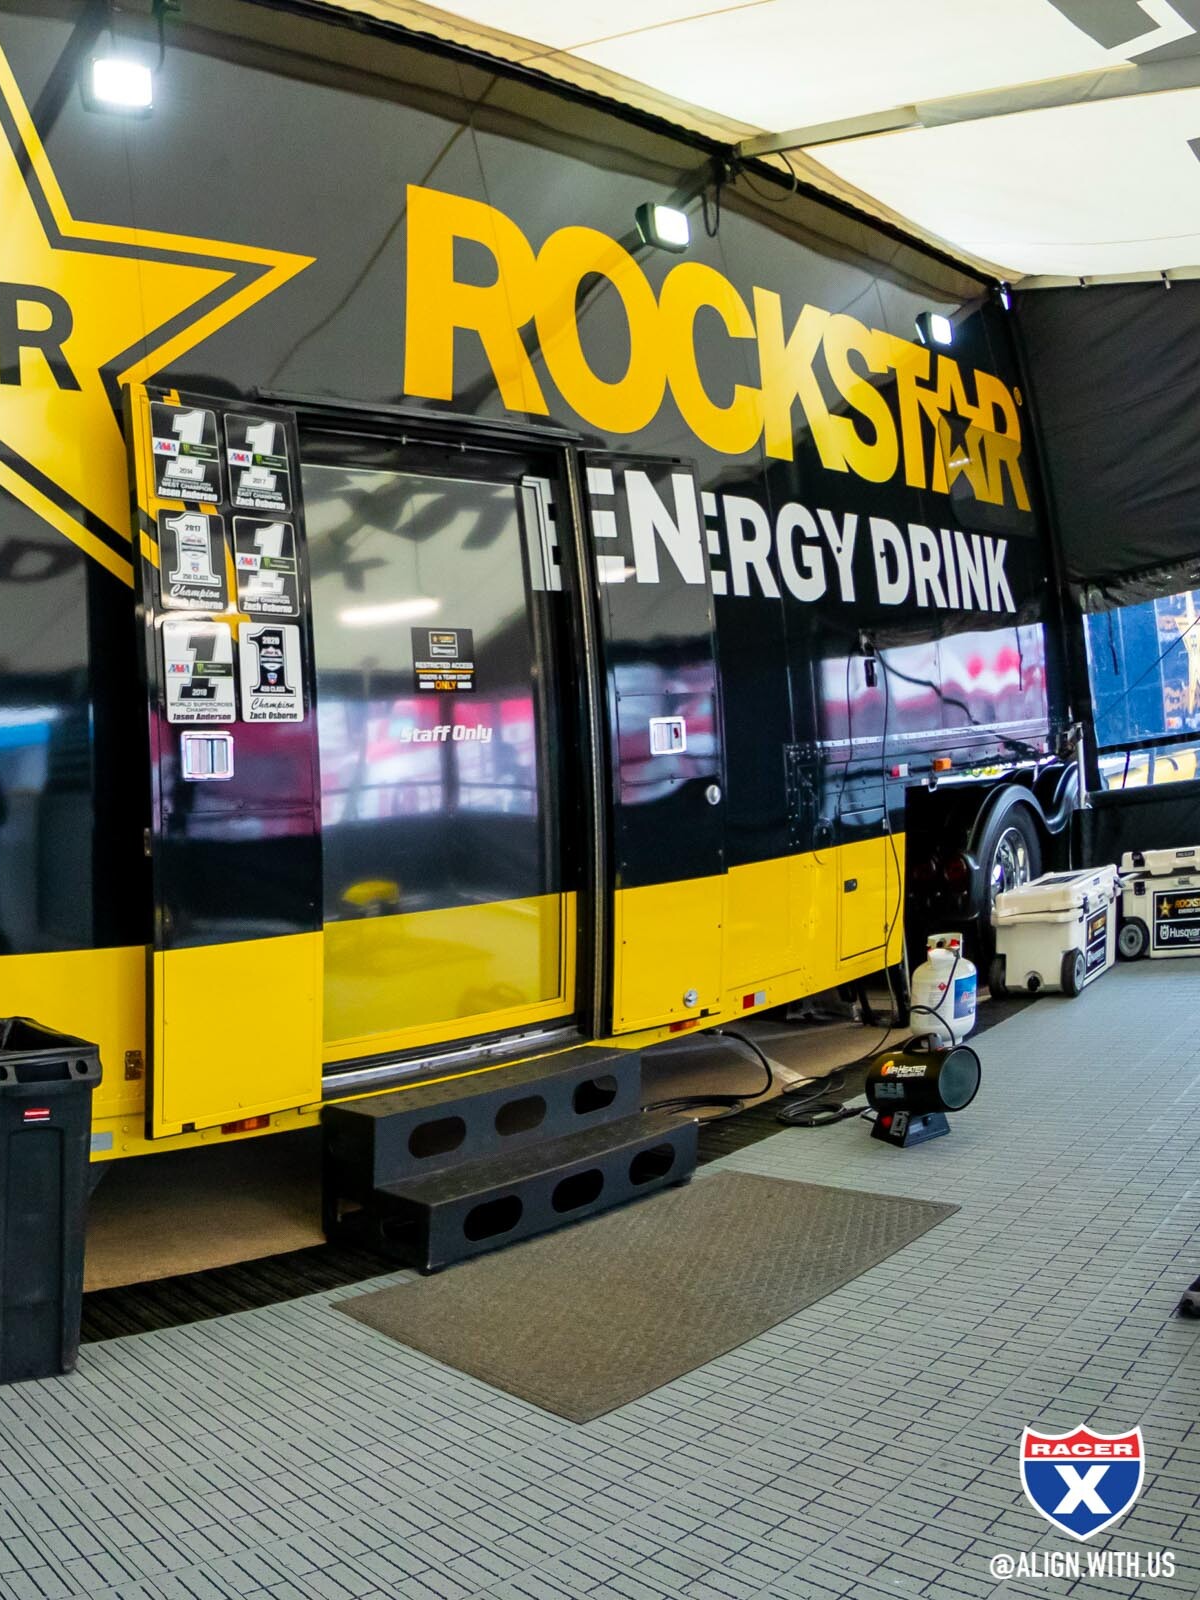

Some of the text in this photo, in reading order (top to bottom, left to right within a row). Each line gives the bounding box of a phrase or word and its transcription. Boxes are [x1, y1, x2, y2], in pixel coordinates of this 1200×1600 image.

[404, 184, 1031, 512] ROCKSTAR
[869, 517, 1016, 613] DRINK
[170, 584, 220, 600] Champion
[435, 680, 457, 690] ONLY
[251, 698, 295, 710] Champion
[196, 713, 231, 721] Anderson
[250, 712, 298, 720] Zach Osborne
[400, 724, 493, 743] Staff Only
